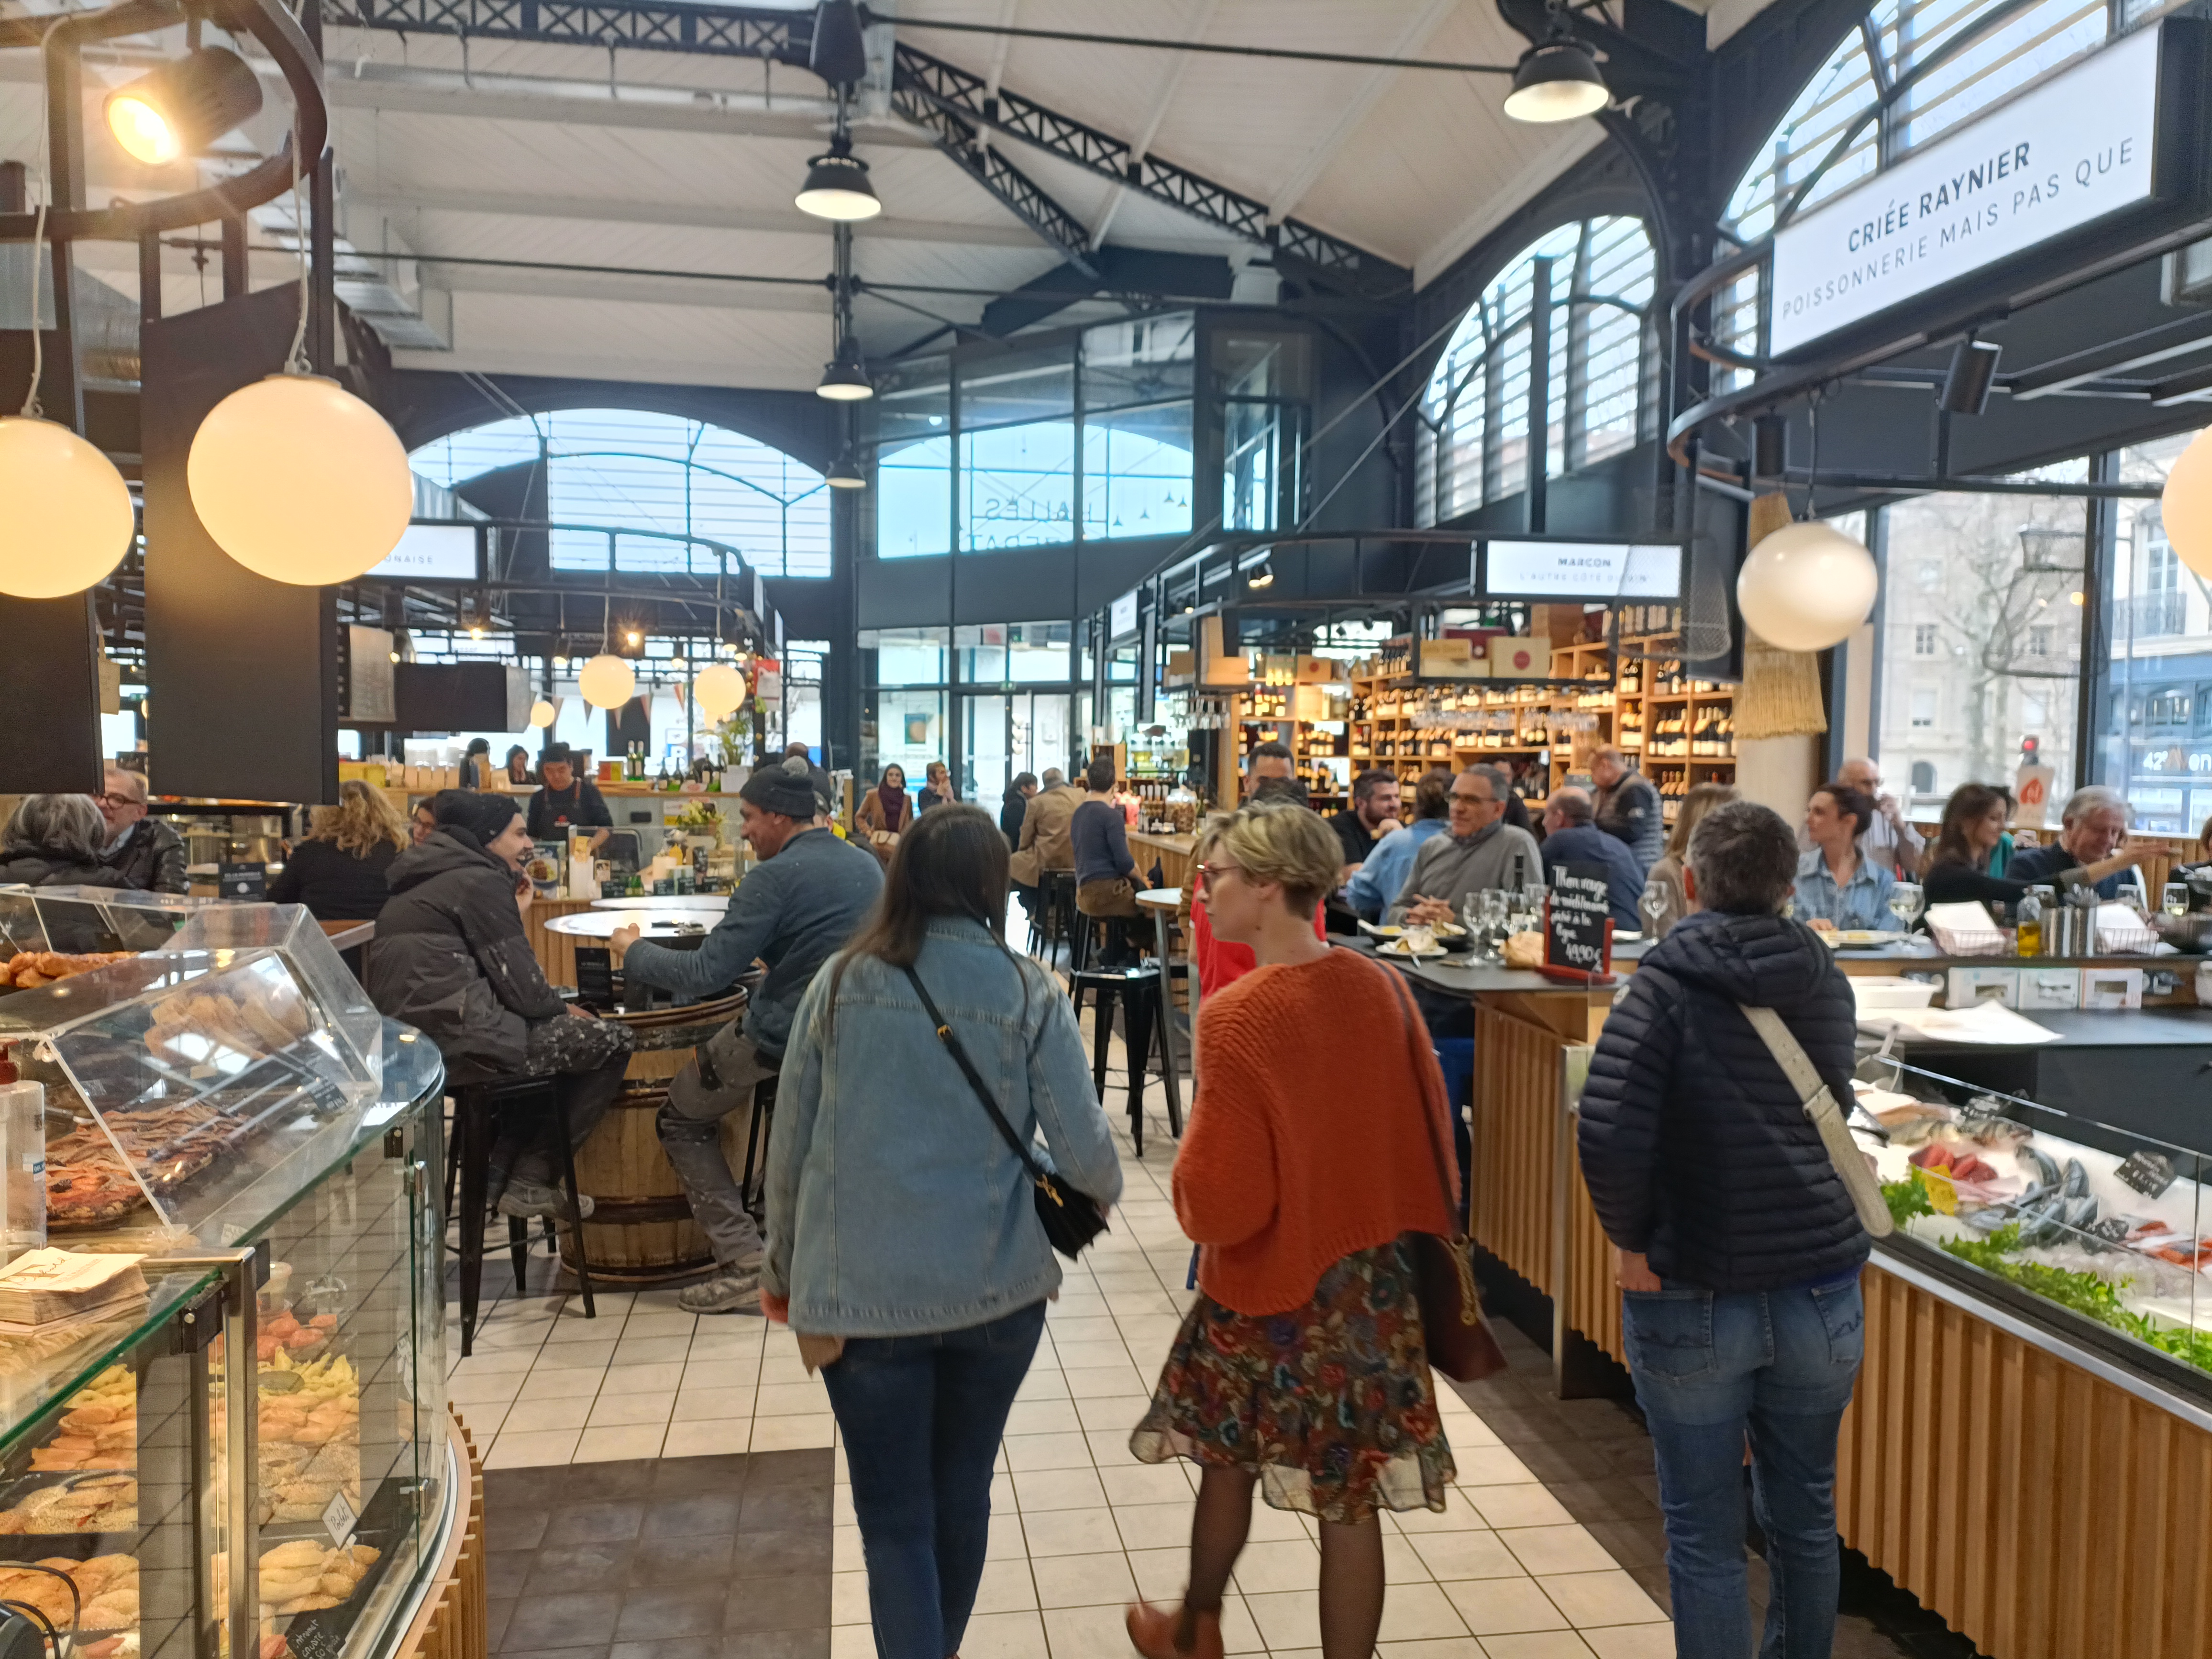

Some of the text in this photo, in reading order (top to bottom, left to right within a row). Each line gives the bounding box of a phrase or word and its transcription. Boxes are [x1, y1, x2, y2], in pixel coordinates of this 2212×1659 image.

[1848, 142, 2030, 252] CRIÉE RAYNIER
[1783, 138, 2134, 320] POISSONNERIE MAIS PAS QUE
[384, 553, 433, 564] ONAISE
[1558, 557, 1611, 567] MARCON
